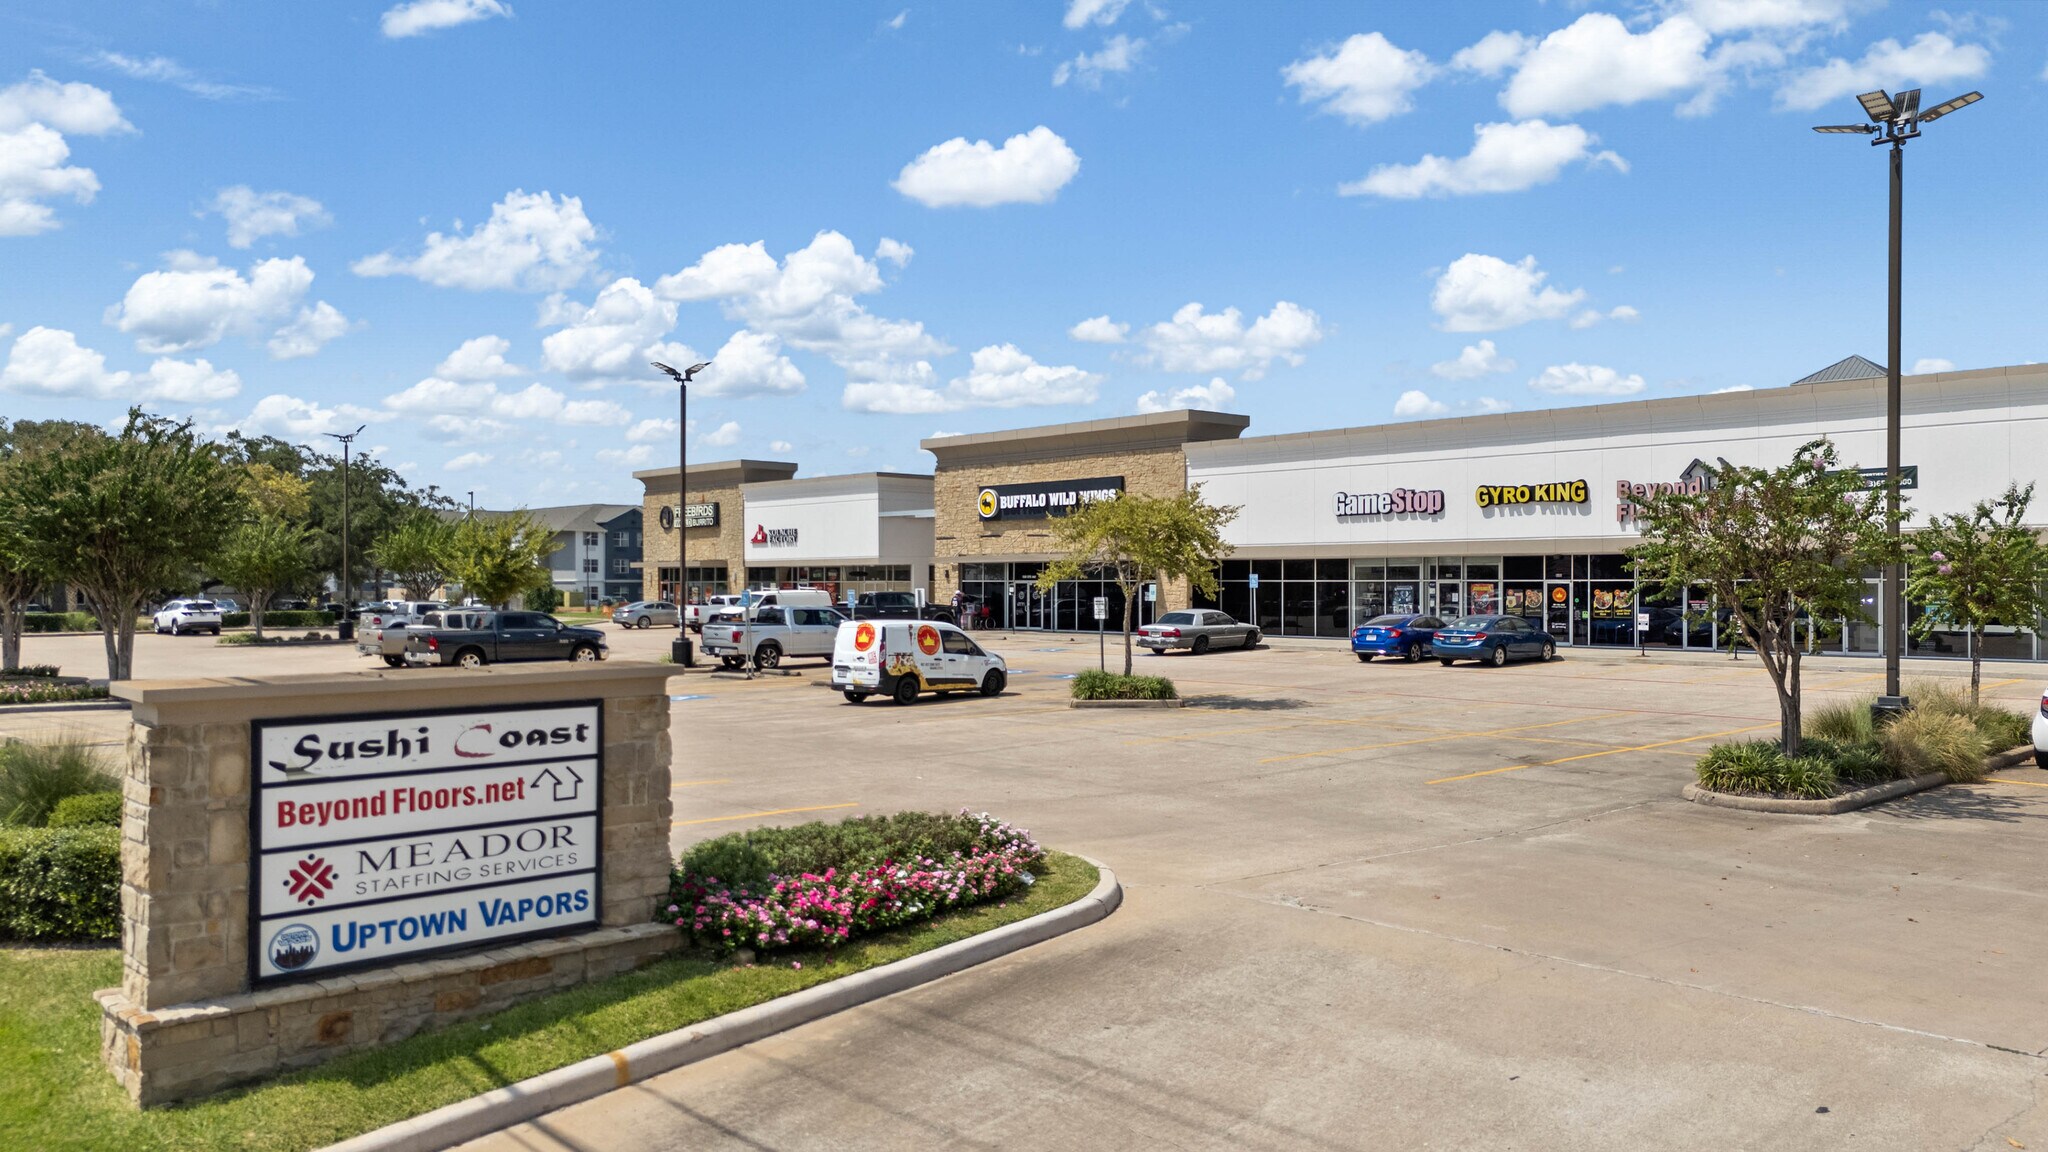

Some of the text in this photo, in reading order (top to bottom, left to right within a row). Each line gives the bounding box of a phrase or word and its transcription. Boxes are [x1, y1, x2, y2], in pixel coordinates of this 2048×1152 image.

[1000, 493, 1046, 509] BUFFALO
[1048, 490, 1077, 507] WILD
[1332, 487, 1444, 516] GameStop
[1477, 480, 1586, 507] GYRO KING
[1617, 476, 1702, 501] Beyond
[269, 723, 590, 772] Sushi Coast
[356, 825, 578, 875] MEADOR
[355, 852, 578, 895] STAFFING SERVICES
[331, 908, 467, 953] UPTOWN
[478, 889, 589, 928] VAPORS
